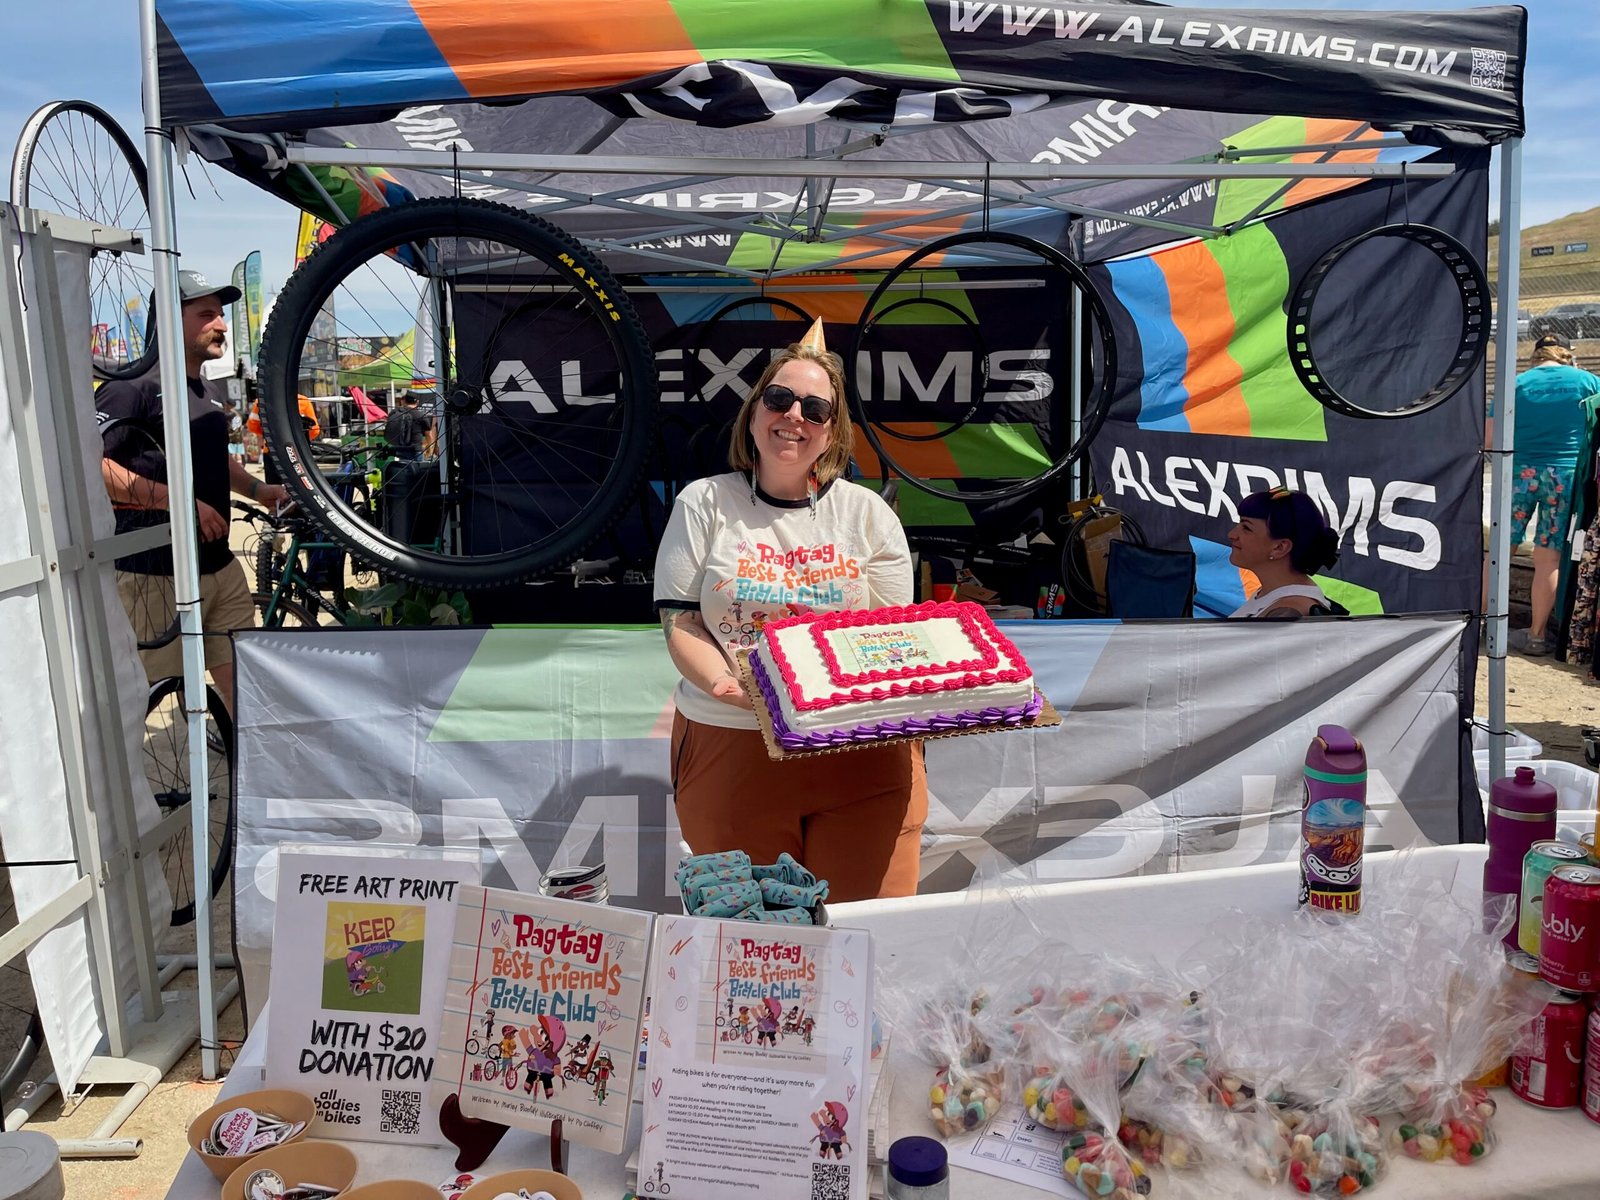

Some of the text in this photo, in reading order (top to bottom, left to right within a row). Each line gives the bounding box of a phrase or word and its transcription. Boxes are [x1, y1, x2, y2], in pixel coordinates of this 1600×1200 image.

[948, 1, 1458, 77] WWW.ALEXRIMS.COM
[558, 252, 622, 323] MAXXIS
[477, 345, 1055, 414] ALEXIMS
[757, 543, 834, 569] Ragtag
[798, 582, 843, 606] Club
[299, 874, 459, 901] FREE ART PRINT
[1311, 892, 1343, 912] BIKE
[343, 917, 396, 945] KEEP
[513, 914, 603, 964] Ragtag
[741, 938, 801, 964] Ragtag
[490, 978, 597, 1023] Bicycle Club
[729, 978, 801, 1000] Bicycle Club
[310, 1019, 426, 1051] WITH $20
[299, 1049, 434, 1082] DONATION
[672, 1068, 689, 1076] Riding
[690, 1069, 704, 1077] bikes
[776, 1079, 788, 1087] way
[320, 1089, 337, 1100] all
[737, 1085, 753, 1094] riding
[314, 1098, 361, 1112] bodies
[324, 1110, 361, 1125] bikes
